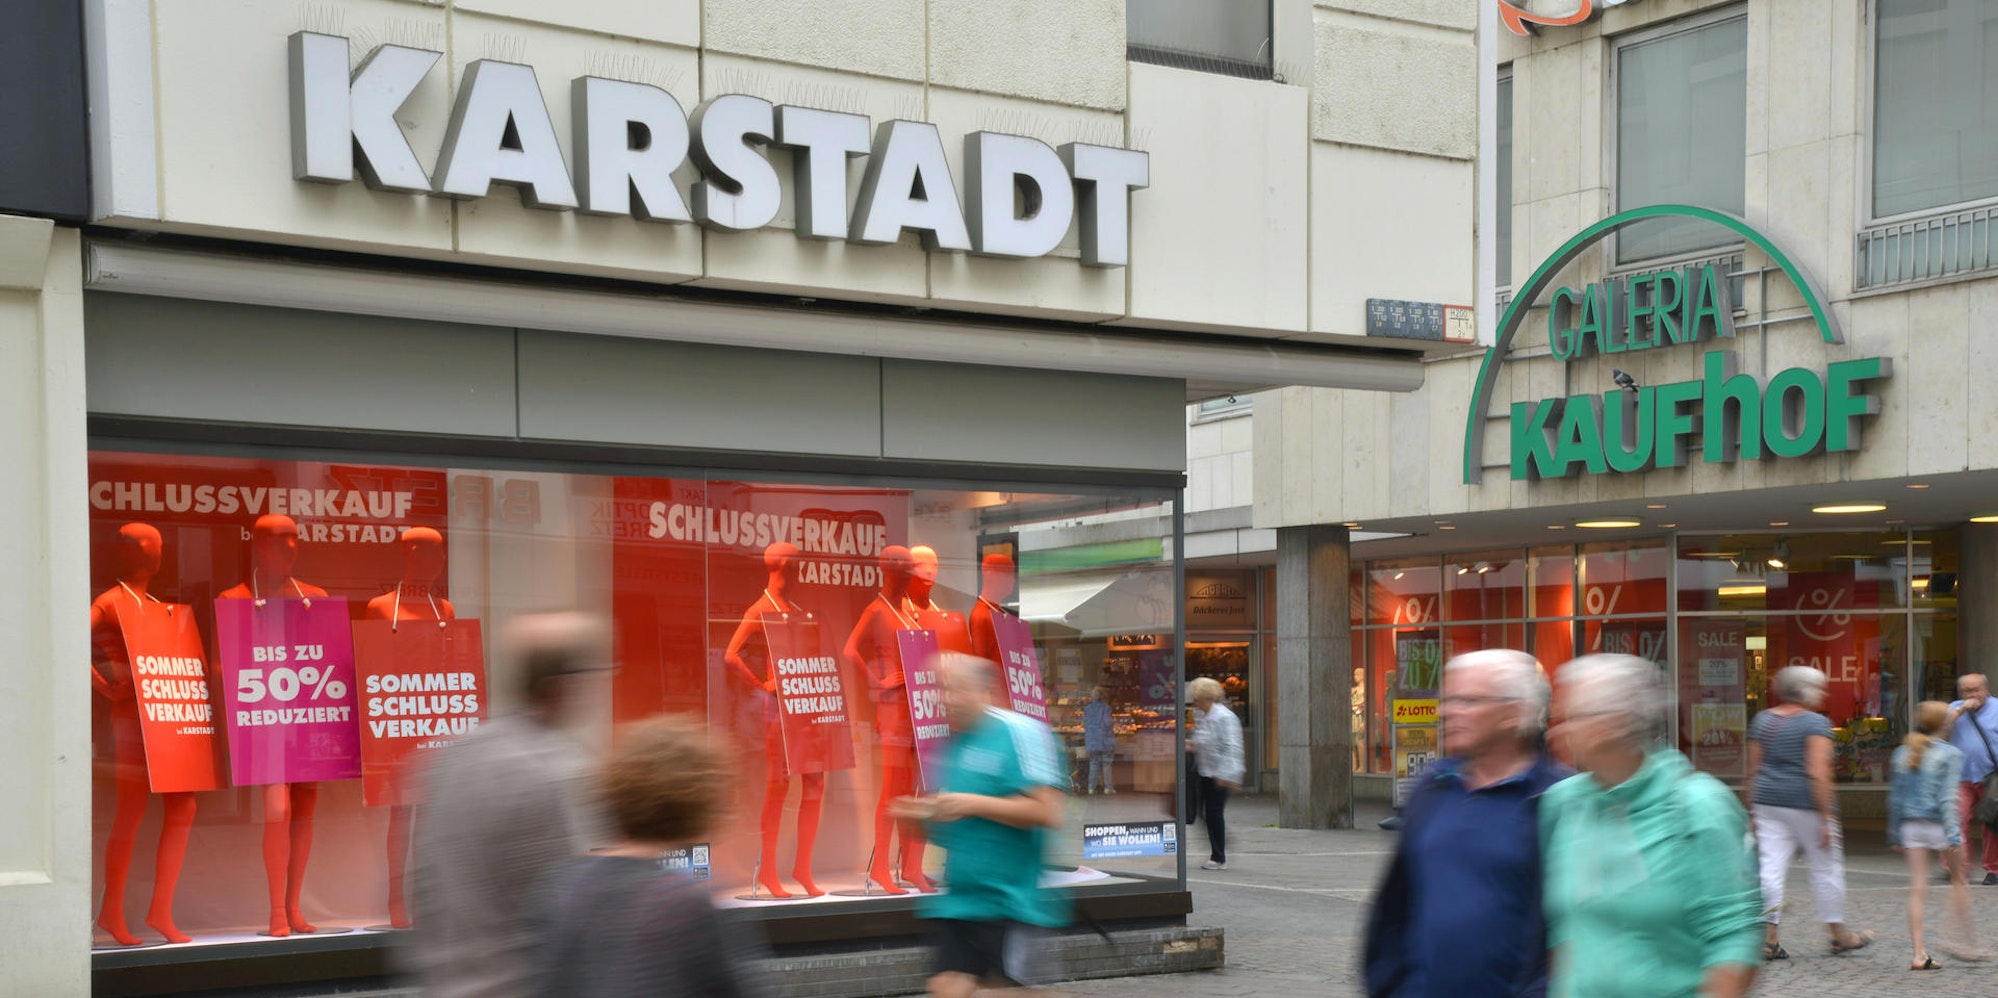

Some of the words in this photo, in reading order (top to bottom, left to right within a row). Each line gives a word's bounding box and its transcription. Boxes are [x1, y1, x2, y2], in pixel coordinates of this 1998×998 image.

[289, 31, 1149, 268] KARSTADT
[1548, 263, 1733, 362] GALERIA
[297, 523, 411, 544] ARSTAD
[649, 501, 886, 557] SCHLUSSVERKAUF
[1698, 631, 1738, 648] SALE
[253, 646, 287, 662] BIS
[294, 644, 324, 660] ZU
[1009, 650, 1021, 665] BIS
[1021, 653, 1031, 667] ZU
[136, 656, 205, 676] SOMMER
[778, 657, 838, 675] SOMMER
[237, 665, 347, 703] 50%
[366, 672, 477, 694] SOMMER
[782, 676, 840, 695] SCHLUSS
[914, 671, 926, 685] BIS
[1008, 666, 1042, 700] 50%
[141, 679, 209, 700] SCHLUSS
[144, 703, 212, 722] VERKAUF
[368, 694, 479, 717] SCHLUSS
[784, 696, 843, 714] VERKAUF
[913, 688, 947, 720] 50%
[1014, 699, 1047, 718] REDUZIERT
[1408, 705, 1436, 716] LOTTO
[237, 706, 350, 727] REDUZIERT
[183, 727, 214, 735] KARSTADT
[369, 717, 479, 738] VERKAUF
[917, 724, 950, 739] REDUZIERT
[1085, 825, 1129, 837] SHOPPEN,
[1103, 836, 1117, 847] SIE
[1118, 833, 1160, 845] WOLLEN!
